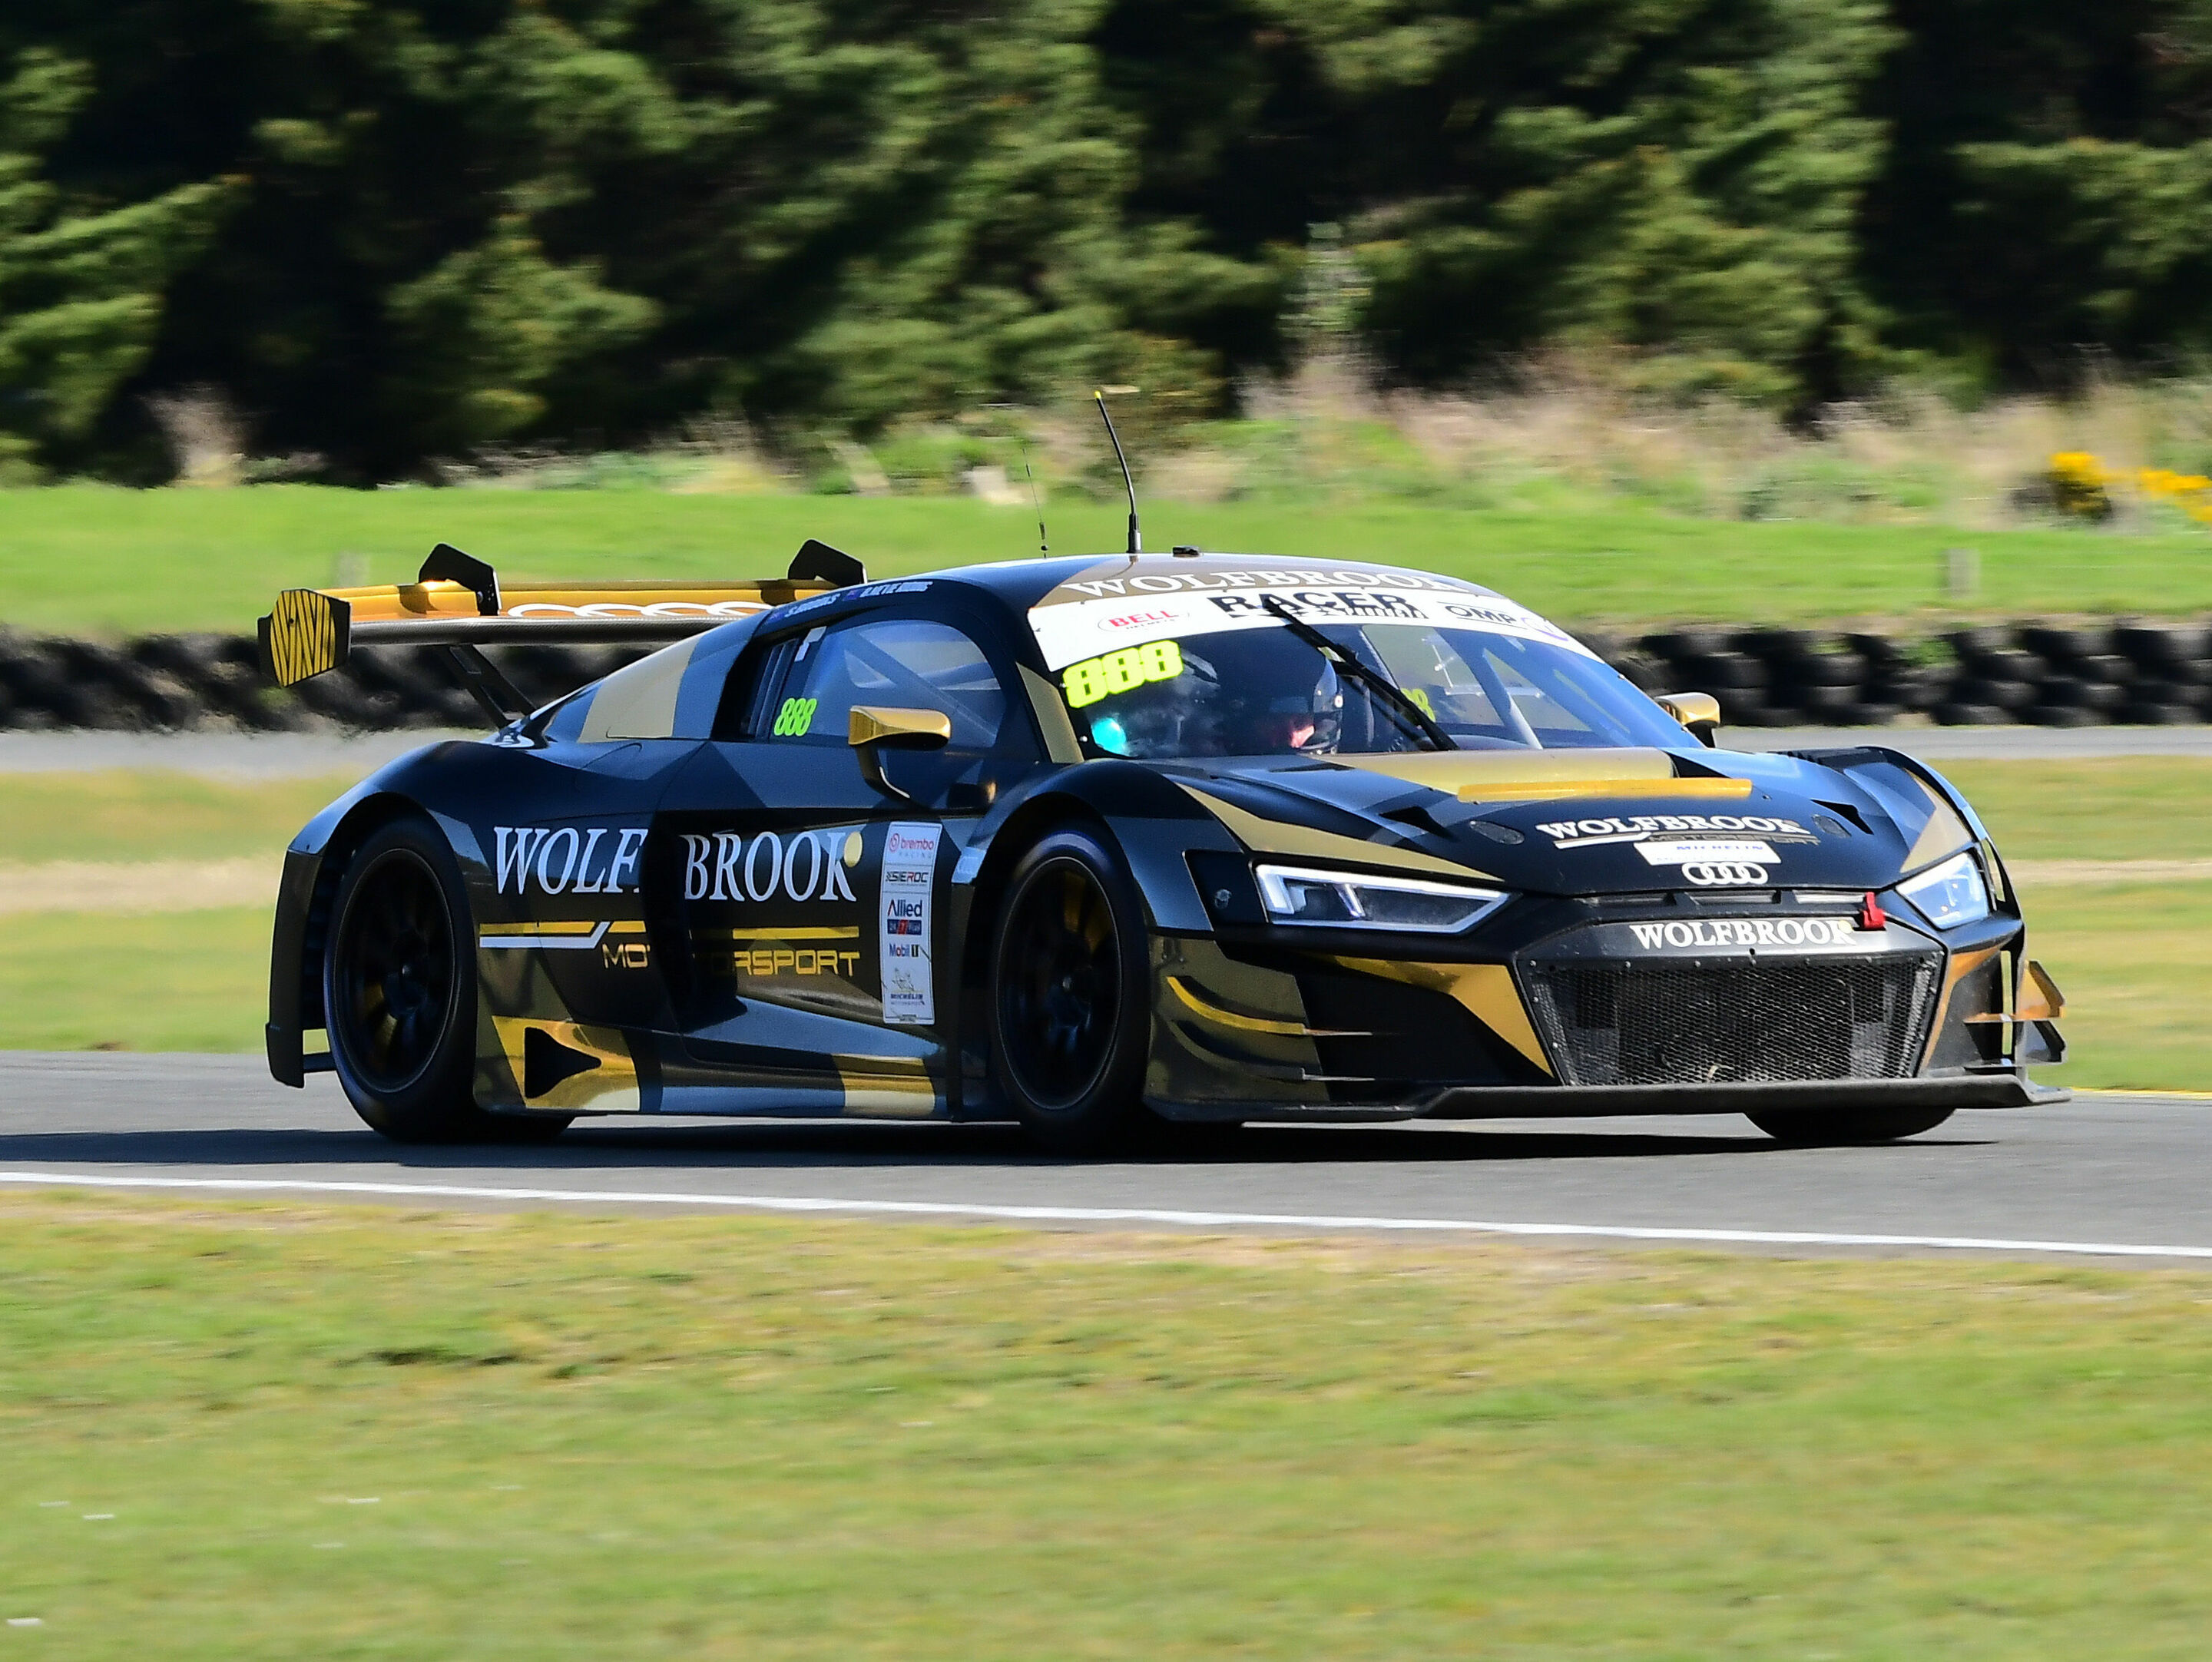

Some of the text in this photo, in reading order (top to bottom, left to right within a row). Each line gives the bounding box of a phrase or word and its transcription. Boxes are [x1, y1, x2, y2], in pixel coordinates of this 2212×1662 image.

[1061, 569, 1470, 597] WOLFBROOK
[1207, 592, 1428, 618] RACER
[1445, 605, 1517, 624] OMP
[1108, 610, 1180, 627] BELL
[1062, 640, 1184, 708] 888
[774, 698, 817, 736] 888
[1535, 816, 1811, 839] WOLFBROOK
[900, 838, 934, 850] brembo
[494, 826, 857, 902] WOLF BROOK
[888, 899, 922, 918] Allied
[1629, 919, 1856, 950] WOLFBROOK
[602, 943, 860, 977] MO RSPORT
[889, 943, 910, 958] Mobil
